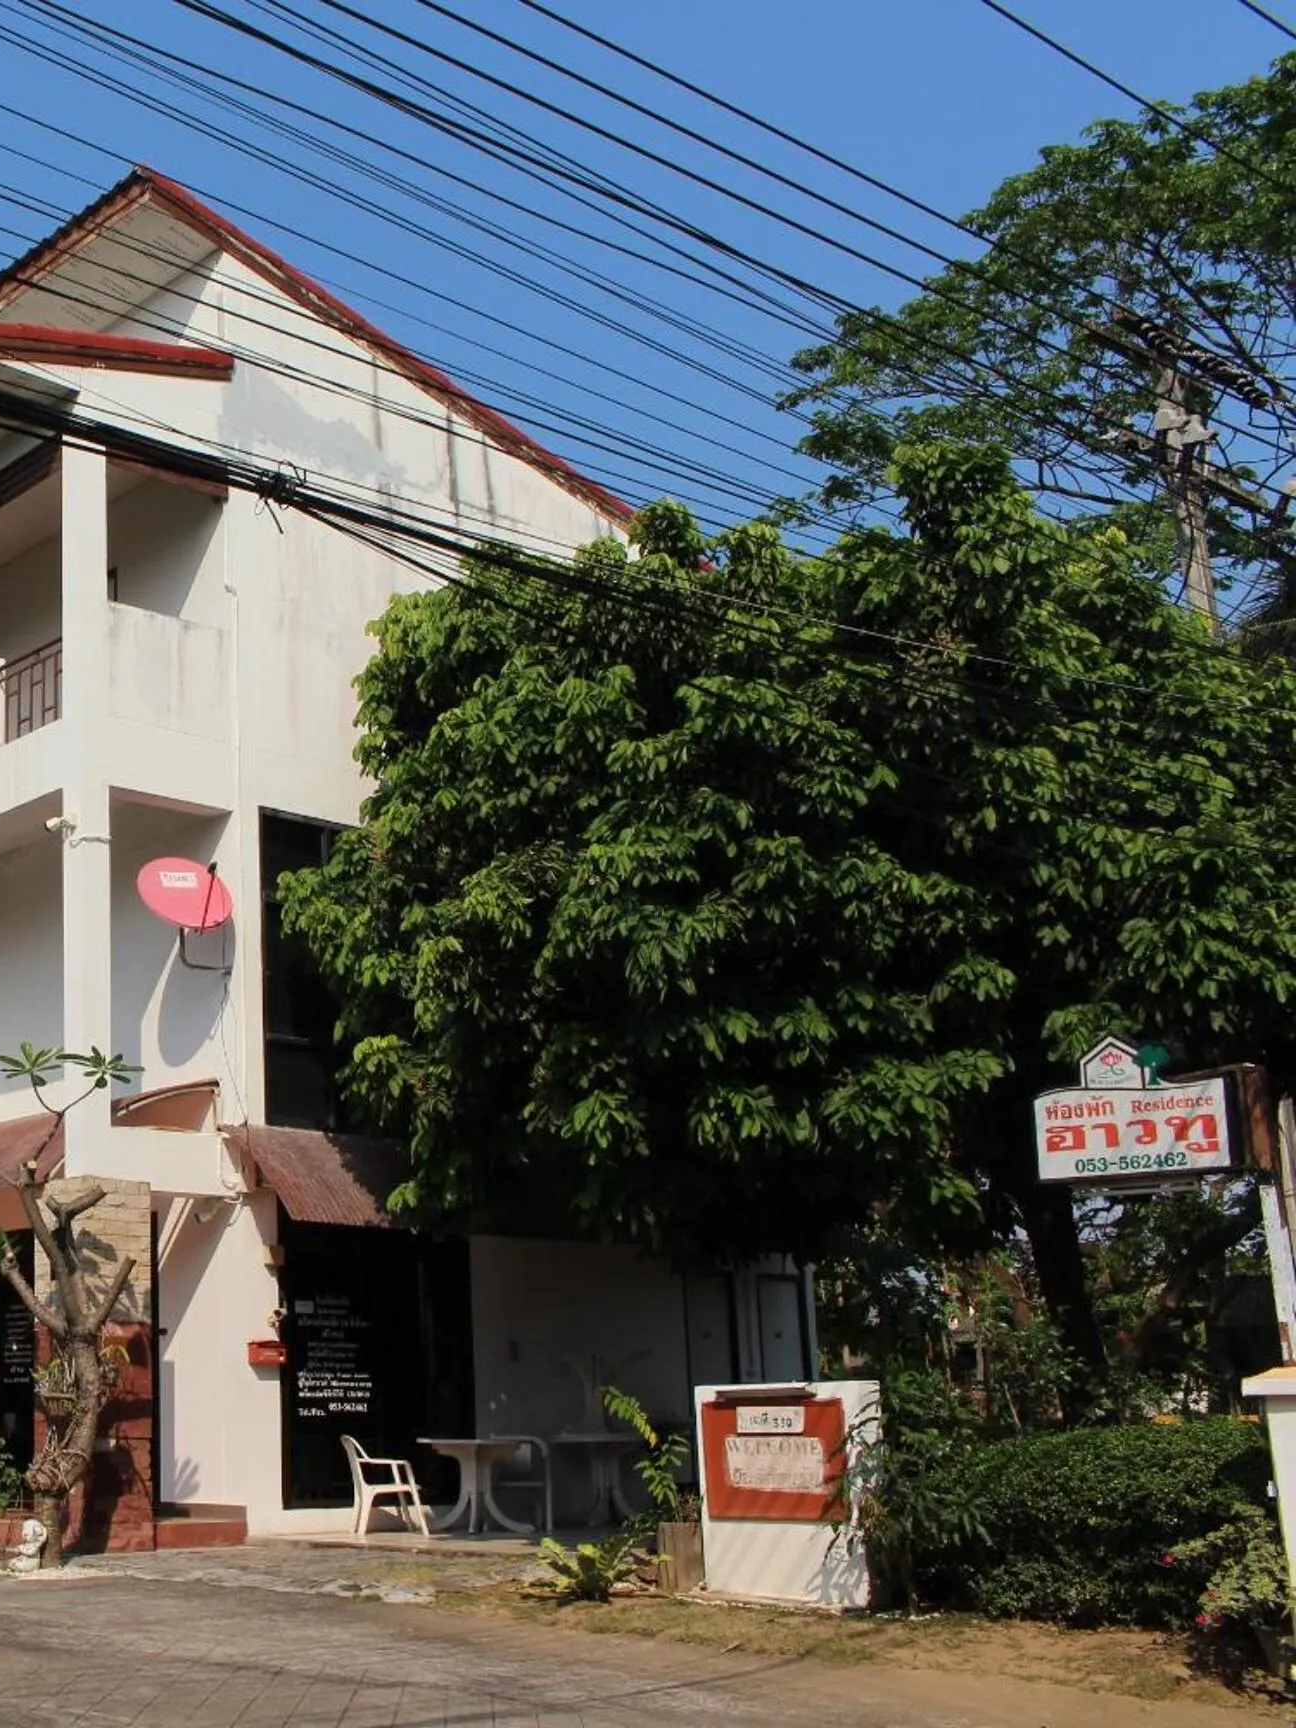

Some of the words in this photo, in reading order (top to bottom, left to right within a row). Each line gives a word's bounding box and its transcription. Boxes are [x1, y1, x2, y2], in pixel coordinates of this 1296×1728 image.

[1045, 1096, 1115, 1120] ห้องพัก
[1131, 1094, 1214, 1114] Residence
[1075, 1152, 1188, 1173] 053-562462
[727, 1438, 820, 1456] WELCOME
